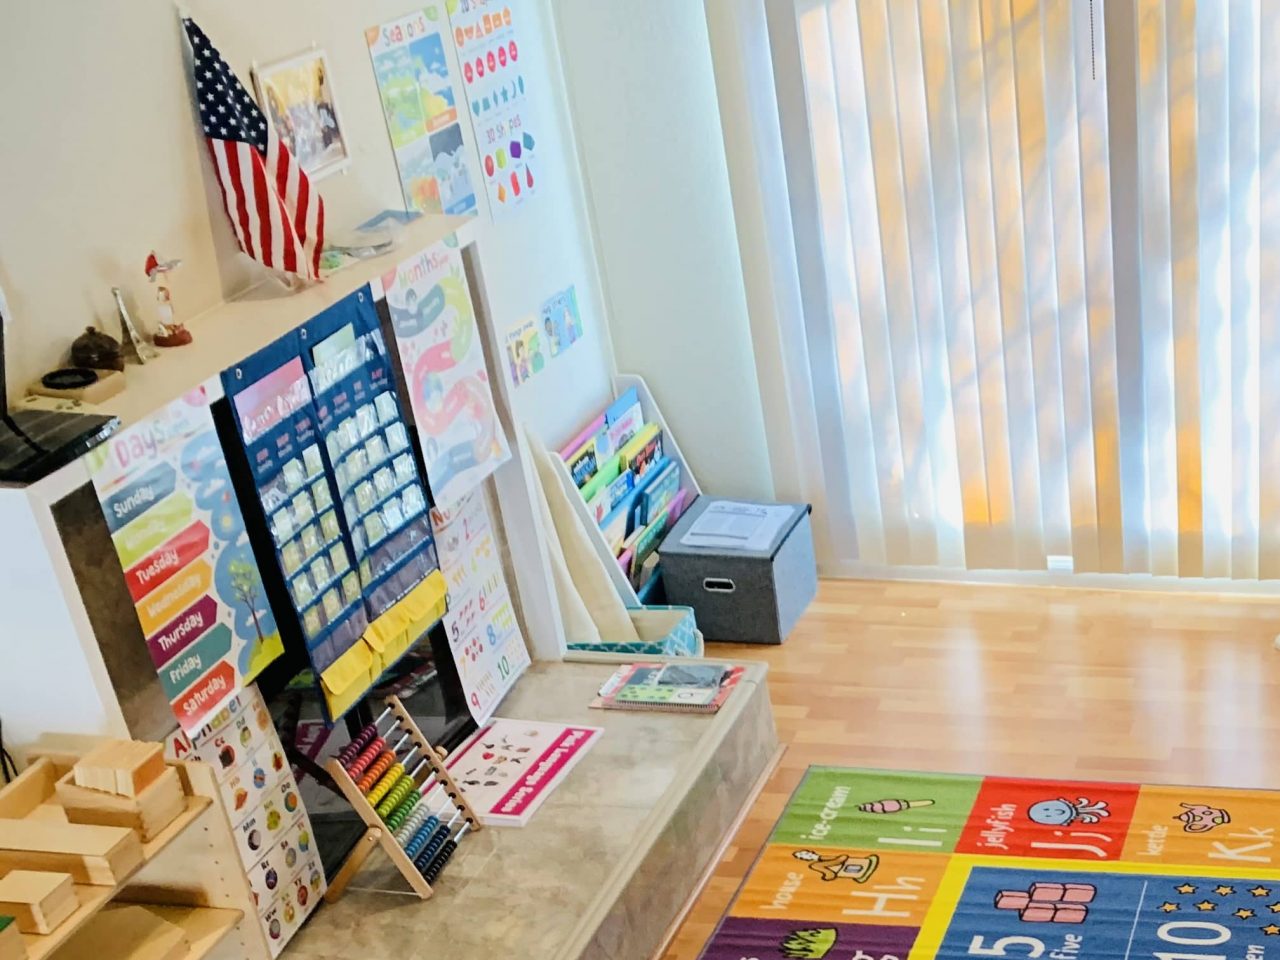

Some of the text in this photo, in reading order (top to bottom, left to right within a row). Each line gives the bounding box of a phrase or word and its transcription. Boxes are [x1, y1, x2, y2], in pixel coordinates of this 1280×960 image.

[115, 420, 166, 469] Days
[113, 486, 155, 518] Sunday
[135, 548, 180, 586] Tuesday
[158, 612, 204, 651] Thursday
[169, 652, 202, 685] Friday
[497, 654, 510, 681] 10
[183, 675, 227, 717] Saturday
[801, 786, 851, 841] ice-cream
[977, 804, 1016, 849] jellyfish
[878, 827, 947, 847] Ii
[1031, 831, 1111, 857] Jj
[1138, 825, 1168, 855] kettle
[1208, 828, 1274, 863] Kk
[761, 872, 803, 909] house
[838, 874, 924, 918] Hh
[968, 936, 1045, 958] 5
[1050, 934, 1082, 960] five
